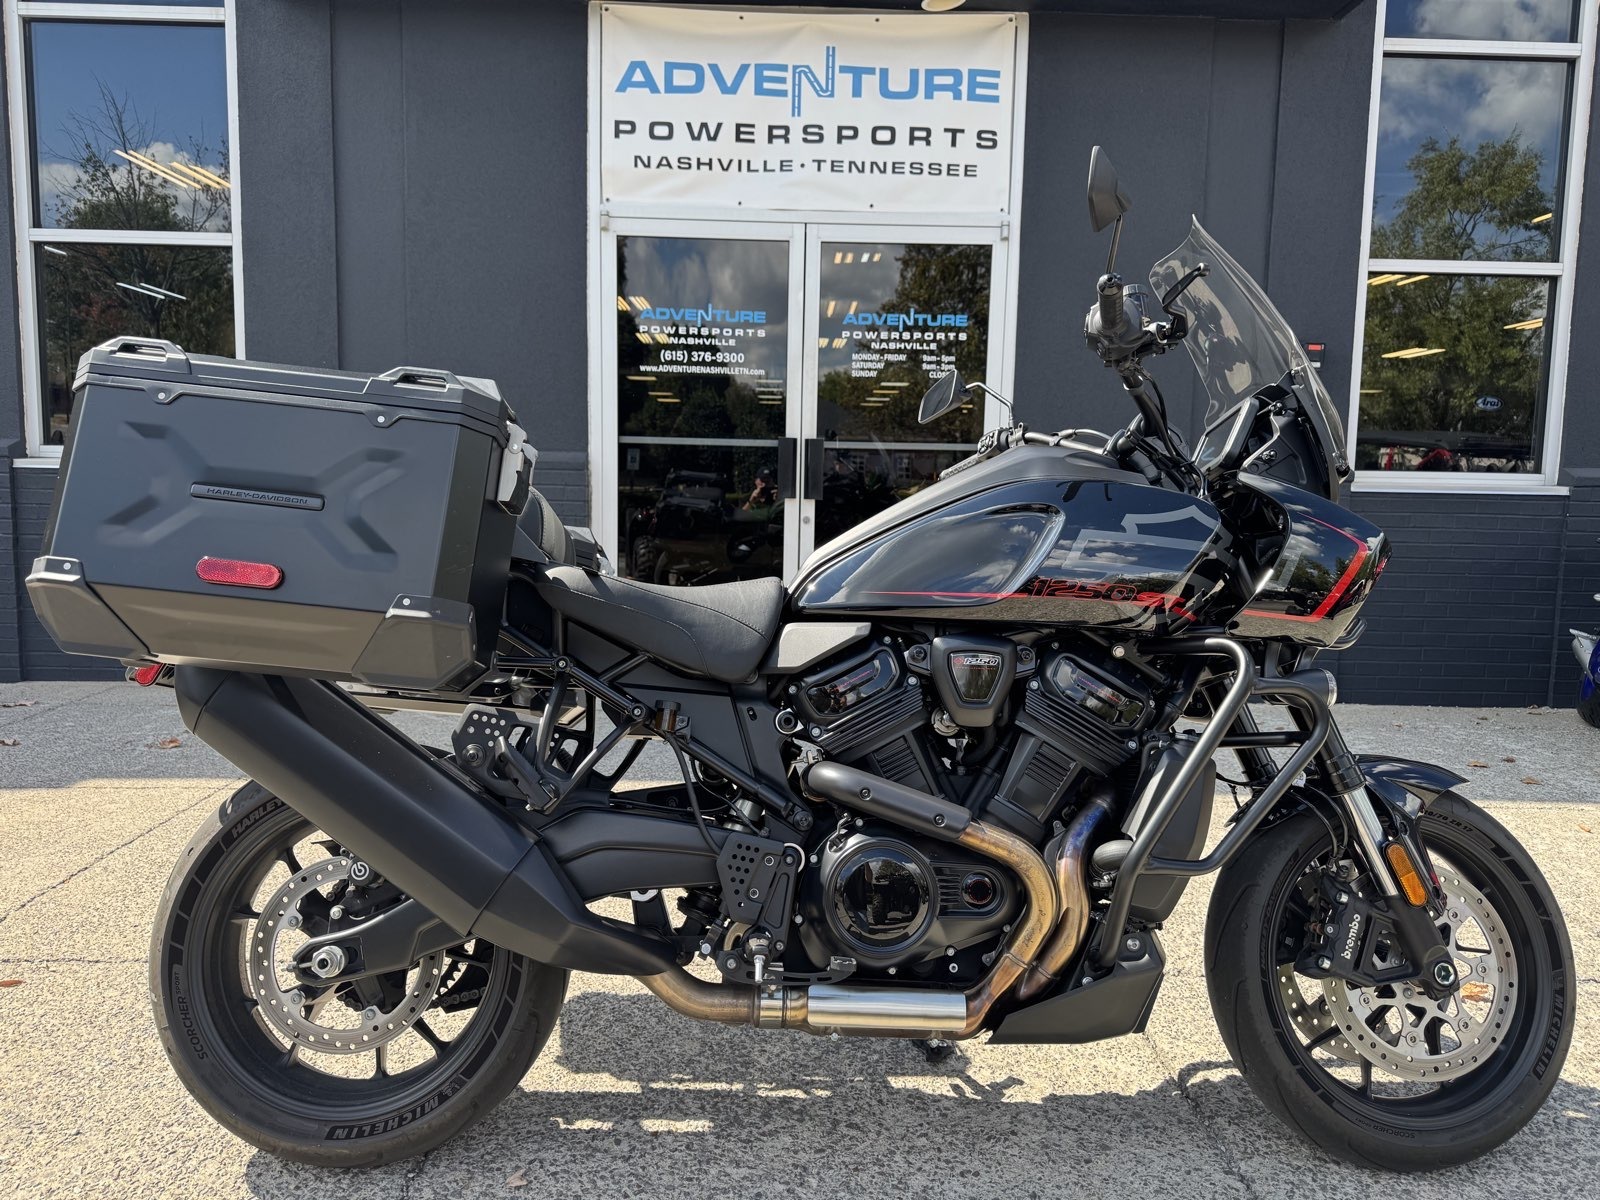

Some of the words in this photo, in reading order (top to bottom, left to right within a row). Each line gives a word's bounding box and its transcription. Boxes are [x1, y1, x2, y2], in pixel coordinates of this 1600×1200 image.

[614, 46, 1001, 117] ADVENTURE
[613, 119, 999, 150] POWERSPORTS
[640, 304, 766, 326] ADVENTURE
[843, 309, 968, 331] ADVENTURE
[639, 325, 766, 337] POWERSPORTS
[842, 331, 968, 341] POWERSPORTS
[668, 337, 736, 346] NASHVILLE
[871, 342, 937, 350] NASHVILLE
[660, 350, 688, 363] (615)
[691, 352, 745, 363] 376-9300
[851, 362, 885, 370] SATURDAY
[851, 370, 878, 378] SUNDAY
[207, 487, 307, 505] HARLEY-DAVIDSON
[1032, 576, 1138, 602] 1250
[1341, 913, 1361, 960] brembo
[178, 996, 209, 1060] SCORCHER
[333, 1096, 439, 1139] MICHELIN
